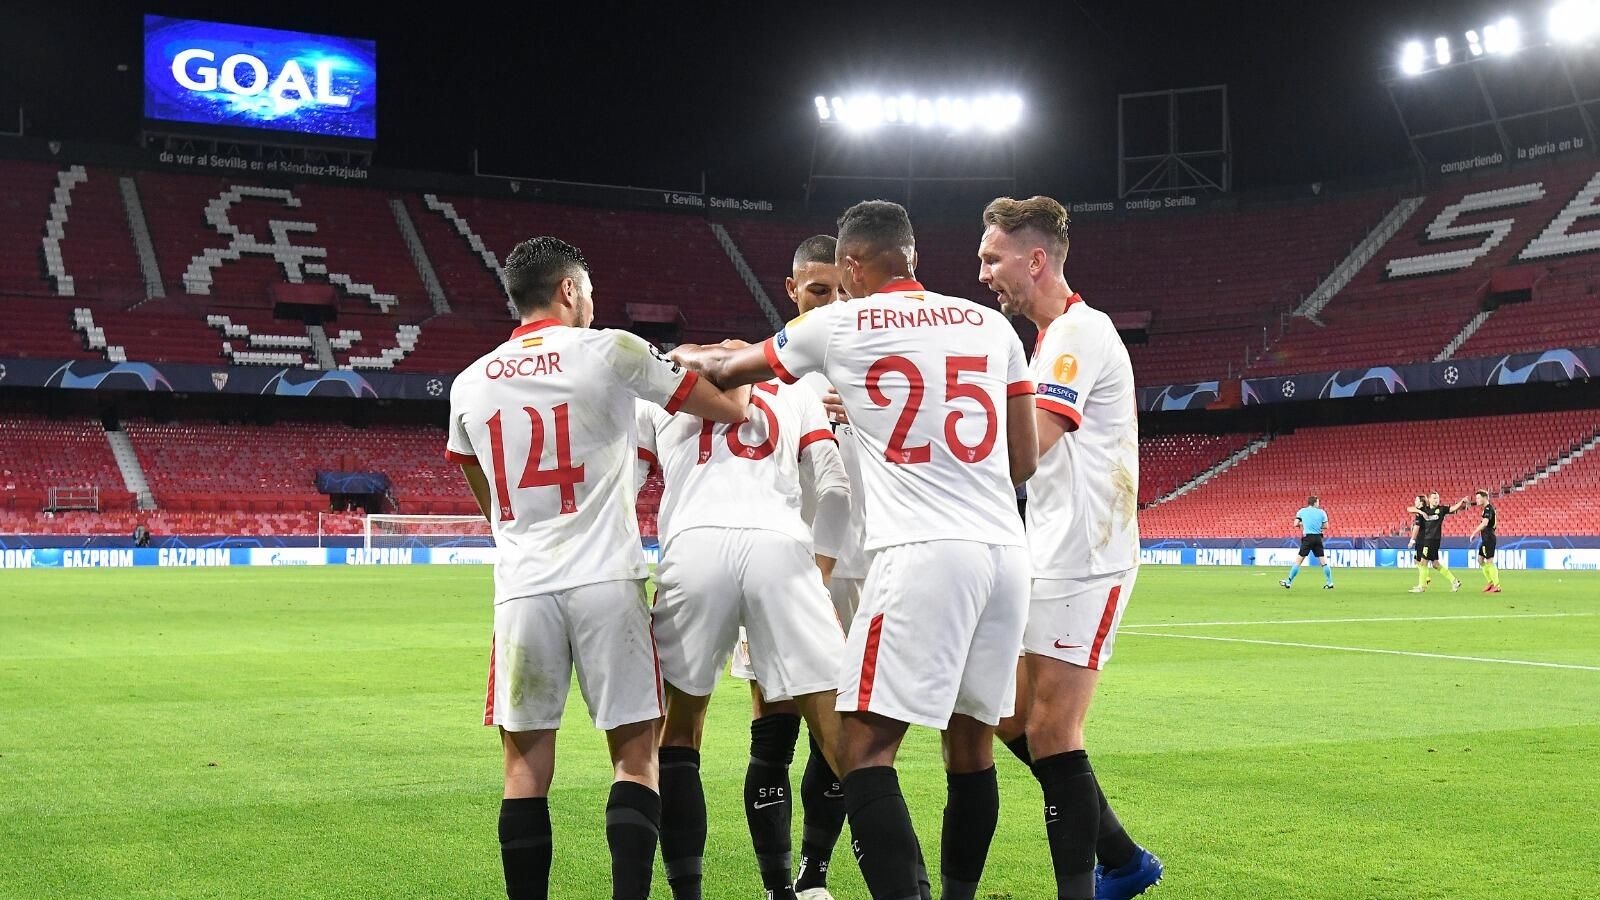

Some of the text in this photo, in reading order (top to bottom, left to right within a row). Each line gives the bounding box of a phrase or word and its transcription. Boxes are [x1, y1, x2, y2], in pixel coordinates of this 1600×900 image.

[171, 48, 351, 107] GOAL
[160, 151, 174, 163] de
[177, 154, 195, 165] ver
[198, 154, 208, 166] al
[210, 155, 248, 169] Sevilla
[250, 159, 264, 170] en
[267, 160, 278, 171] el
[1441, 137, 1584, 173] compartiendo la gloria en tu
[664, 193, 671, 204] Y
[1073, 201, 1114, 213] estamos
[1126, 198, 1162, 211] contigo
[1164, 195, 1197, 208] Sevilla
[857, 306, 984, 331] FERNANDO
[486, 351, 564, 379] ÓSCAR
[1048, 386, 1077, 401] RESPECT
[865, 355, 998, 464] 25
[486, 402, 585, 522] 14
[63, 549, 134, 568] GAZPROM
[158, 548, 231, 567] GAZPROM
[346, 548, 412, 565] GAZPROM
[1140, 549, 1182, 565] GAZPROM
[1196, 549, 1242, 565] GAZPROM
[1323, 549, 1376, 568] GAZPROM
[759, 787, 785, 798] SFC
